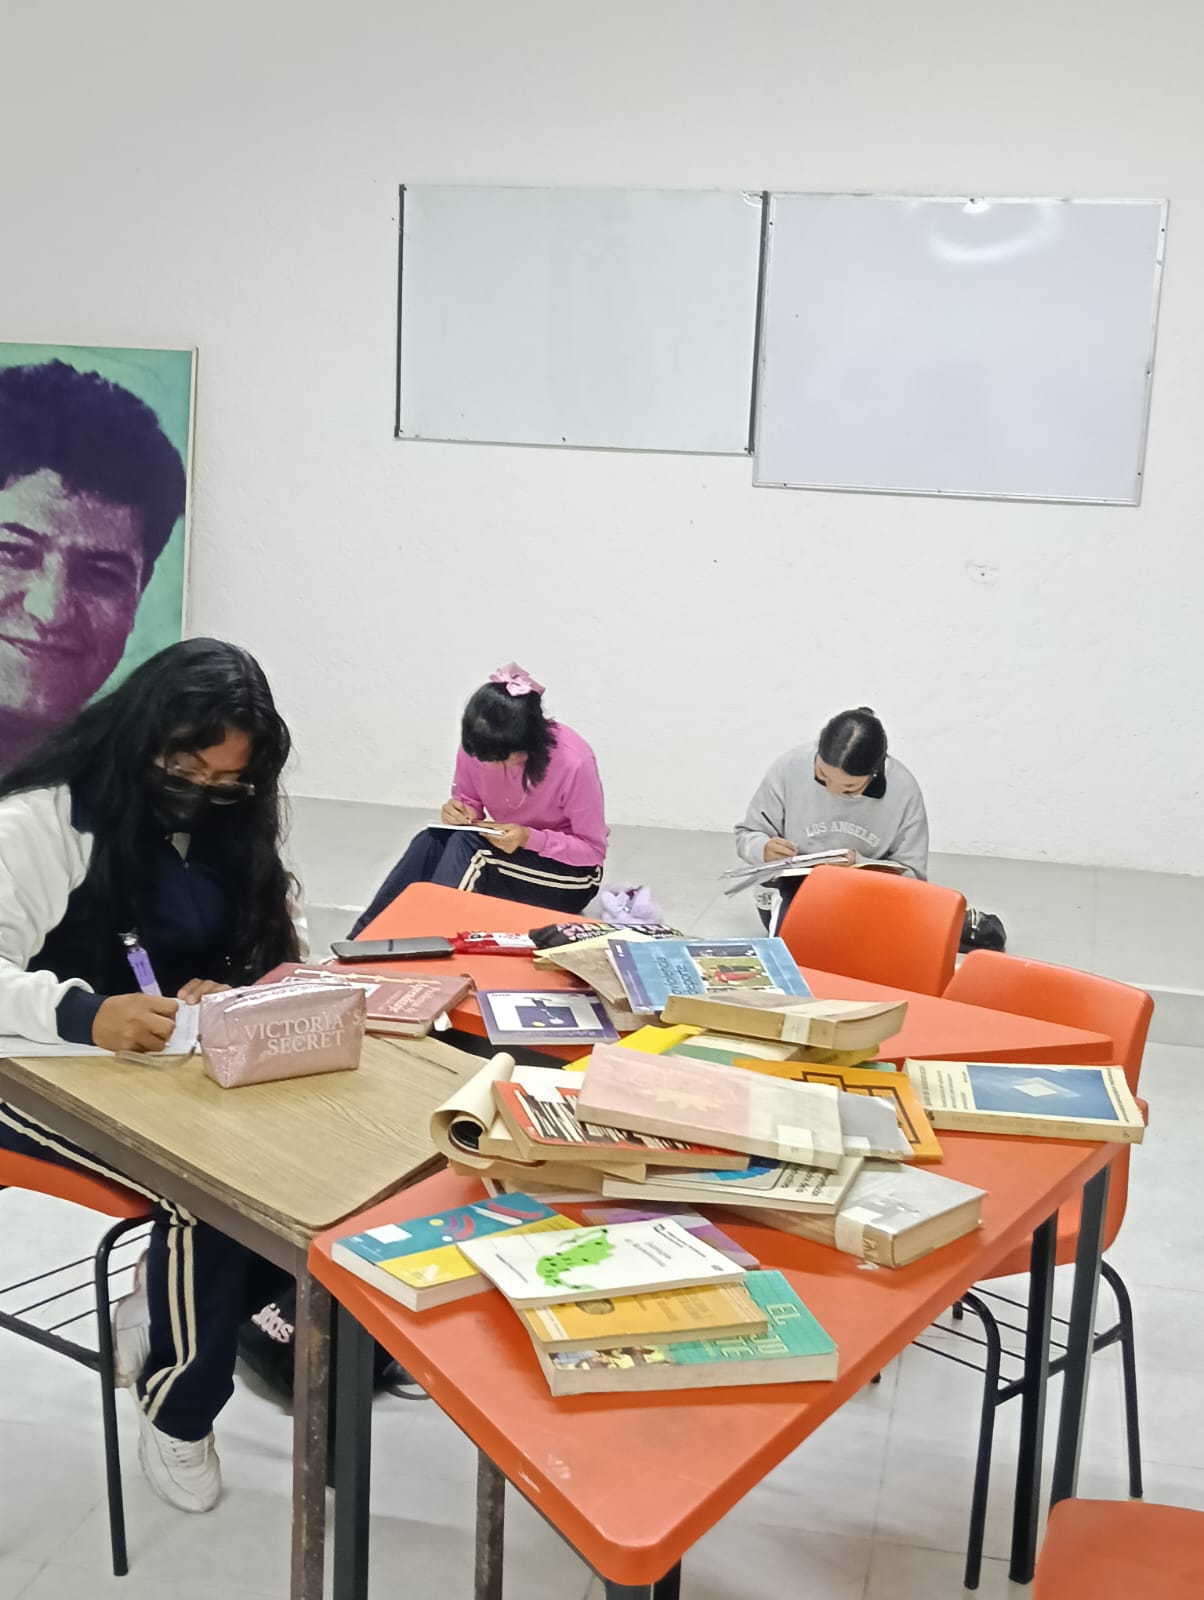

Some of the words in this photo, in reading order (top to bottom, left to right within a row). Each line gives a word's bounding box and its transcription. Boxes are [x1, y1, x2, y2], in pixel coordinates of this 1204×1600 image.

[805, 822, 827, 837] LOS
[831, 821, 881, 848] ANGELES
[266, 1029, 345, 1056] SECRET
